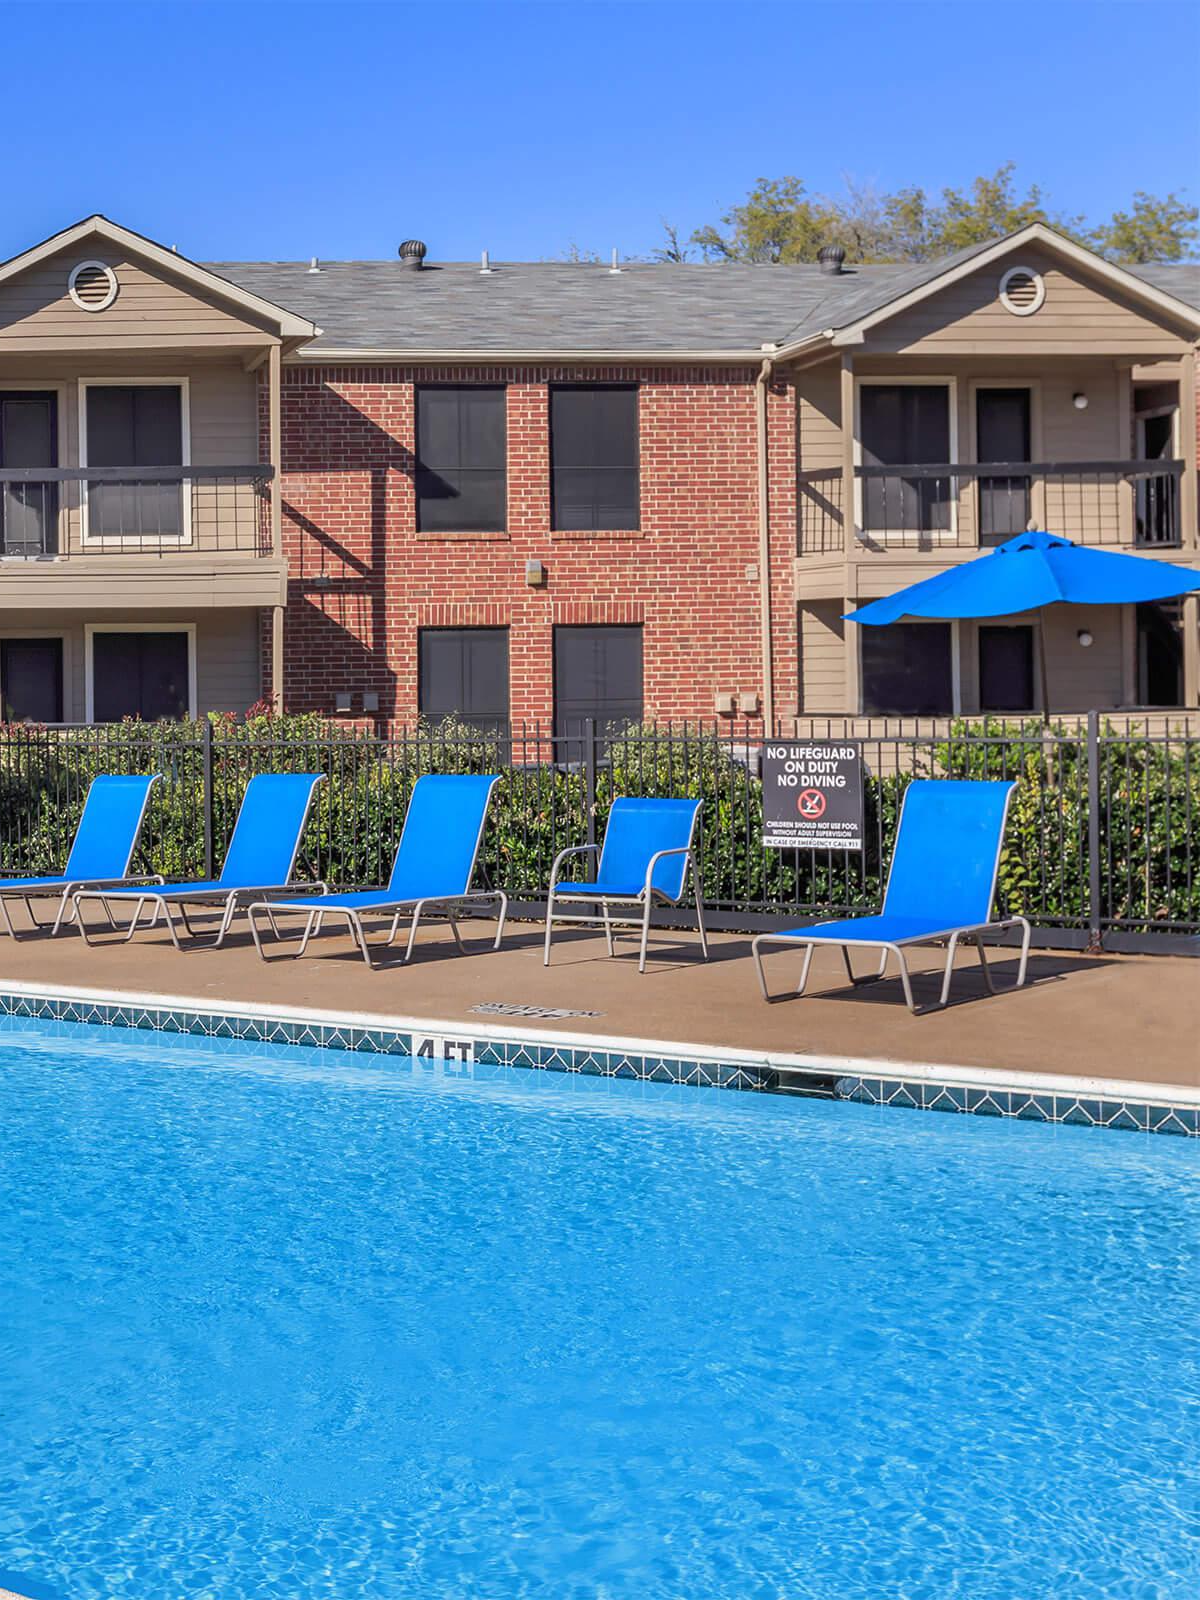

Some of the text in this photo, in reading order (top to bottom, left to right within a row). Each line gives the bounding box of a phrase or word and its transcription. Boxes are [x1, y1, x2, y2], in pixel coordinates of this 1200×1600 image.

[767, 747, 855, 760] NO LIFEGUARD
[784, 761, 838, 773] ON DUTY
[777, 775, 846, 787] NO DIVING
